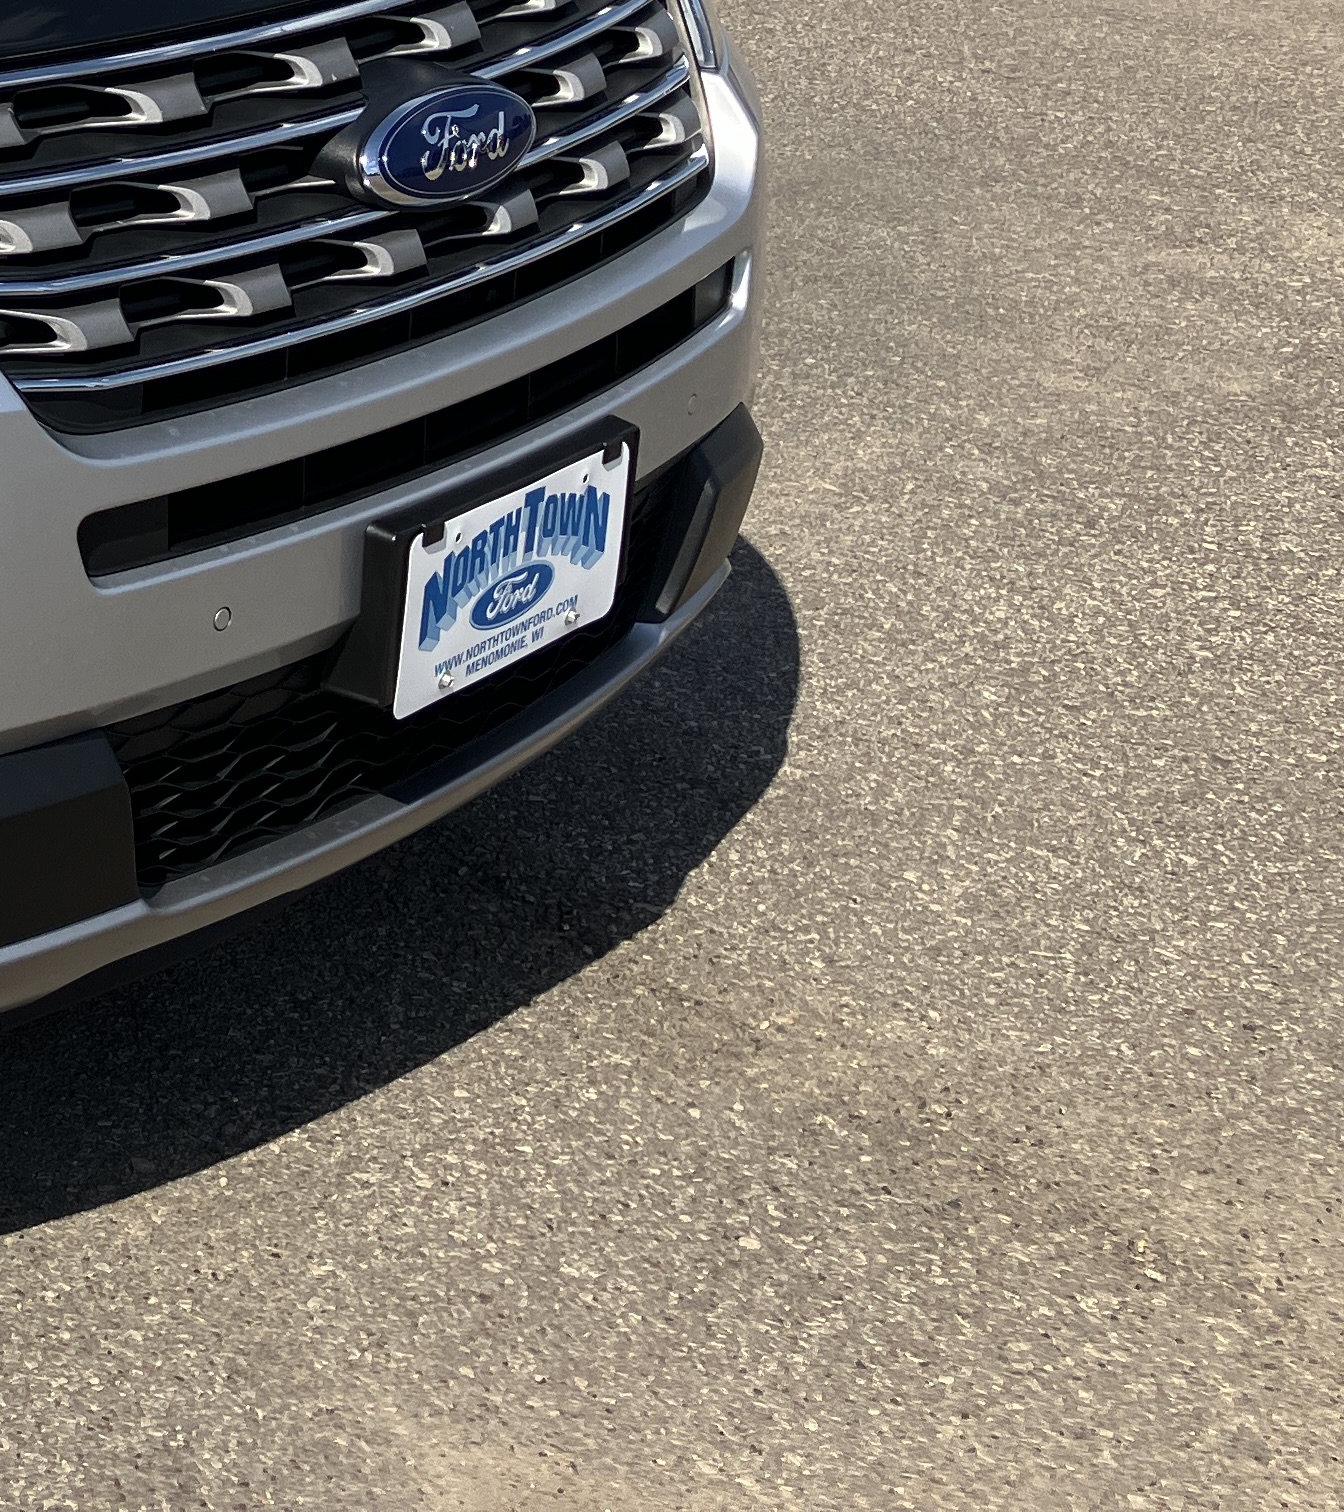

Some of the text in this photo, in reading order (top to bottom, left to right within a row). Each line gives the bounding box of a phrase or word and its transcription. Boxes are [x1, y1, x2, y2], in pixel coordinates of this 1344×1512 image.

[420, 103, 510, 181] Ford
[486, 570, 538, 620] Ford
[434, 594, 578, 676] WWW.NORTHTOWNFORD.COM
[531, 627, 544, 644] WI
